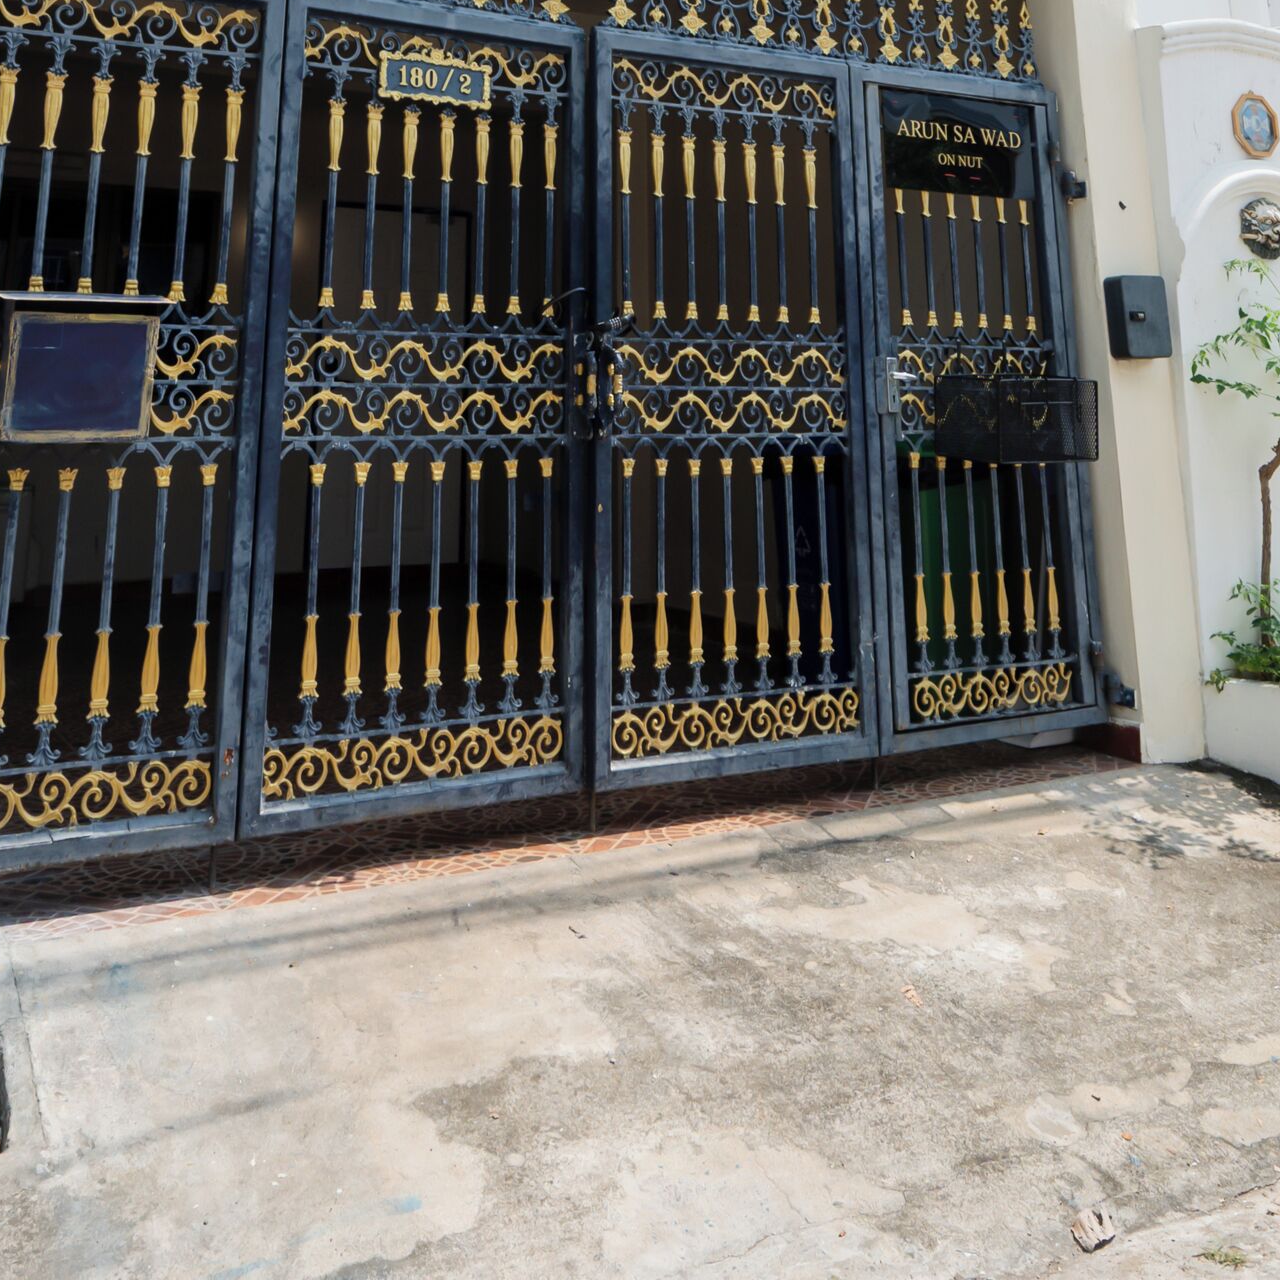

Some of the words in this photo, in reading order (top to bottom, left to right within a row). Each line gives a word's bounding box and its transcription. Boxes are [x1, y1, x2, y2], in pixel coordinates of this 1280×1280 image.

[399, 64, 472, 95] 180/2
[897, 119, 948, 141] ARUN
[953, 125, 977, 145] SA
[980, 128, 1022, 149] WAD
[937, 152, 955, 167] ON
[958, 154, 983, 169] NUT
